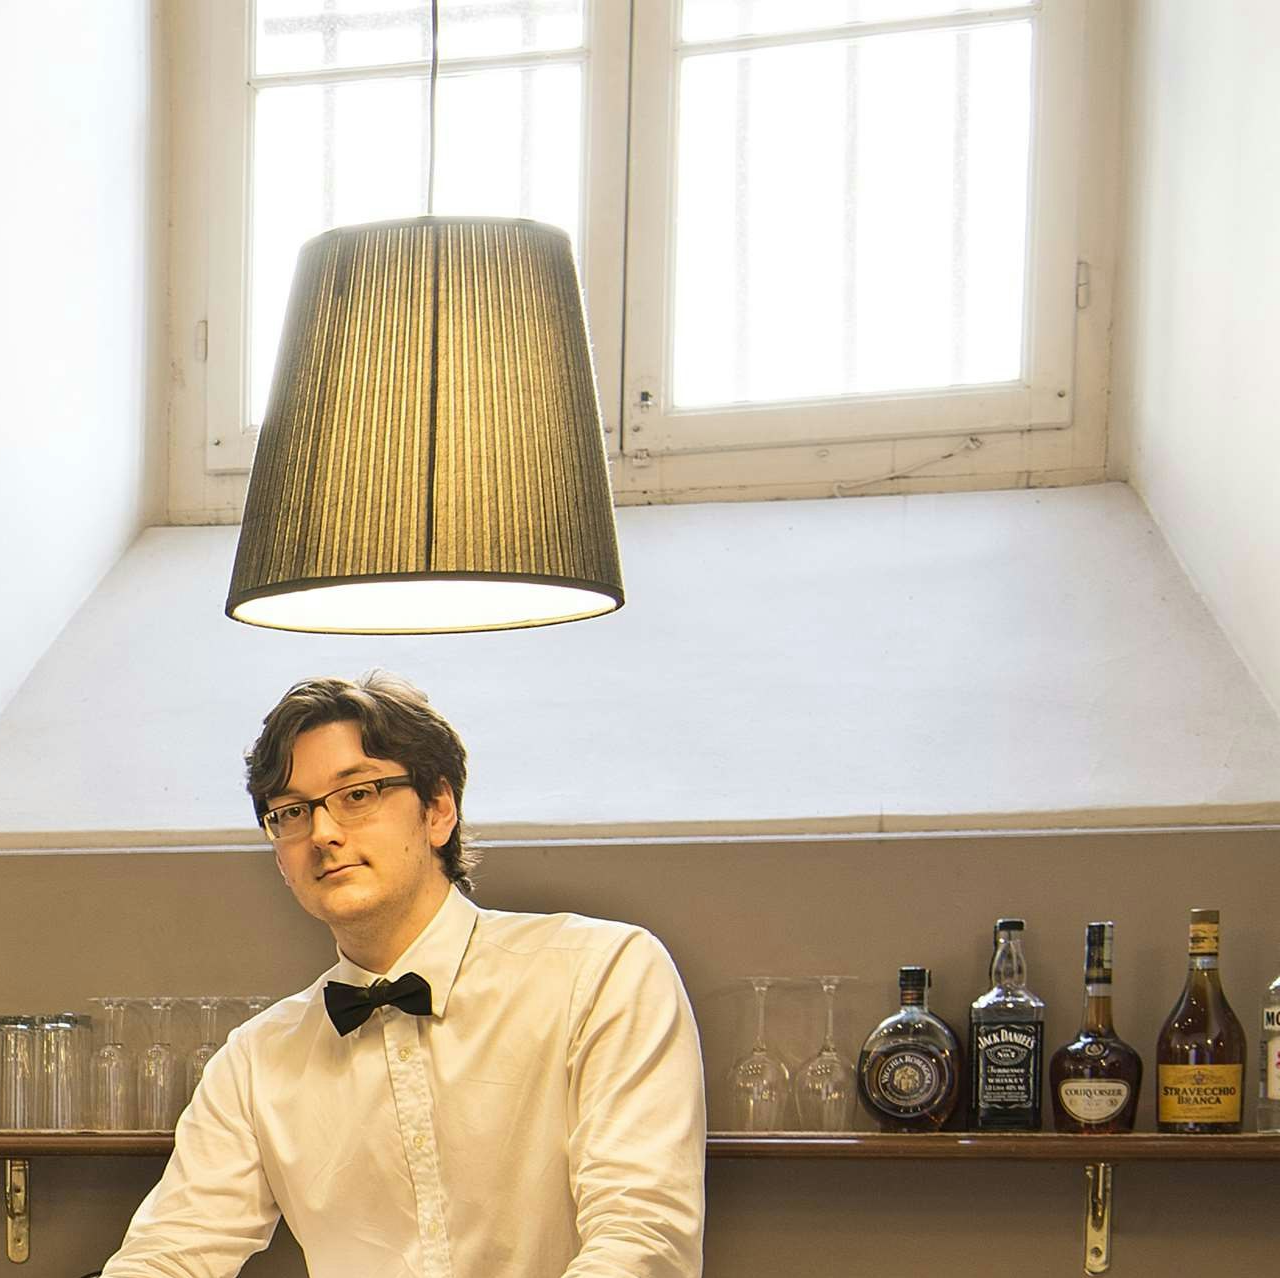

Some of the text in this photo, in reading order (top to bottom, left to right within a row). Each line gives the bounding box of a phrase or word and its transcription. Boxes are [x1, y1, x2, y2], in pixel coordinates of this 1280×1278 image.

[977, 1029, 1036, 1050] JACK DANIEL'S
[1163, 1086, 1237, 1096] STRAVECCHIO
[1177, 1096, 1222, 1105] BRANCA
